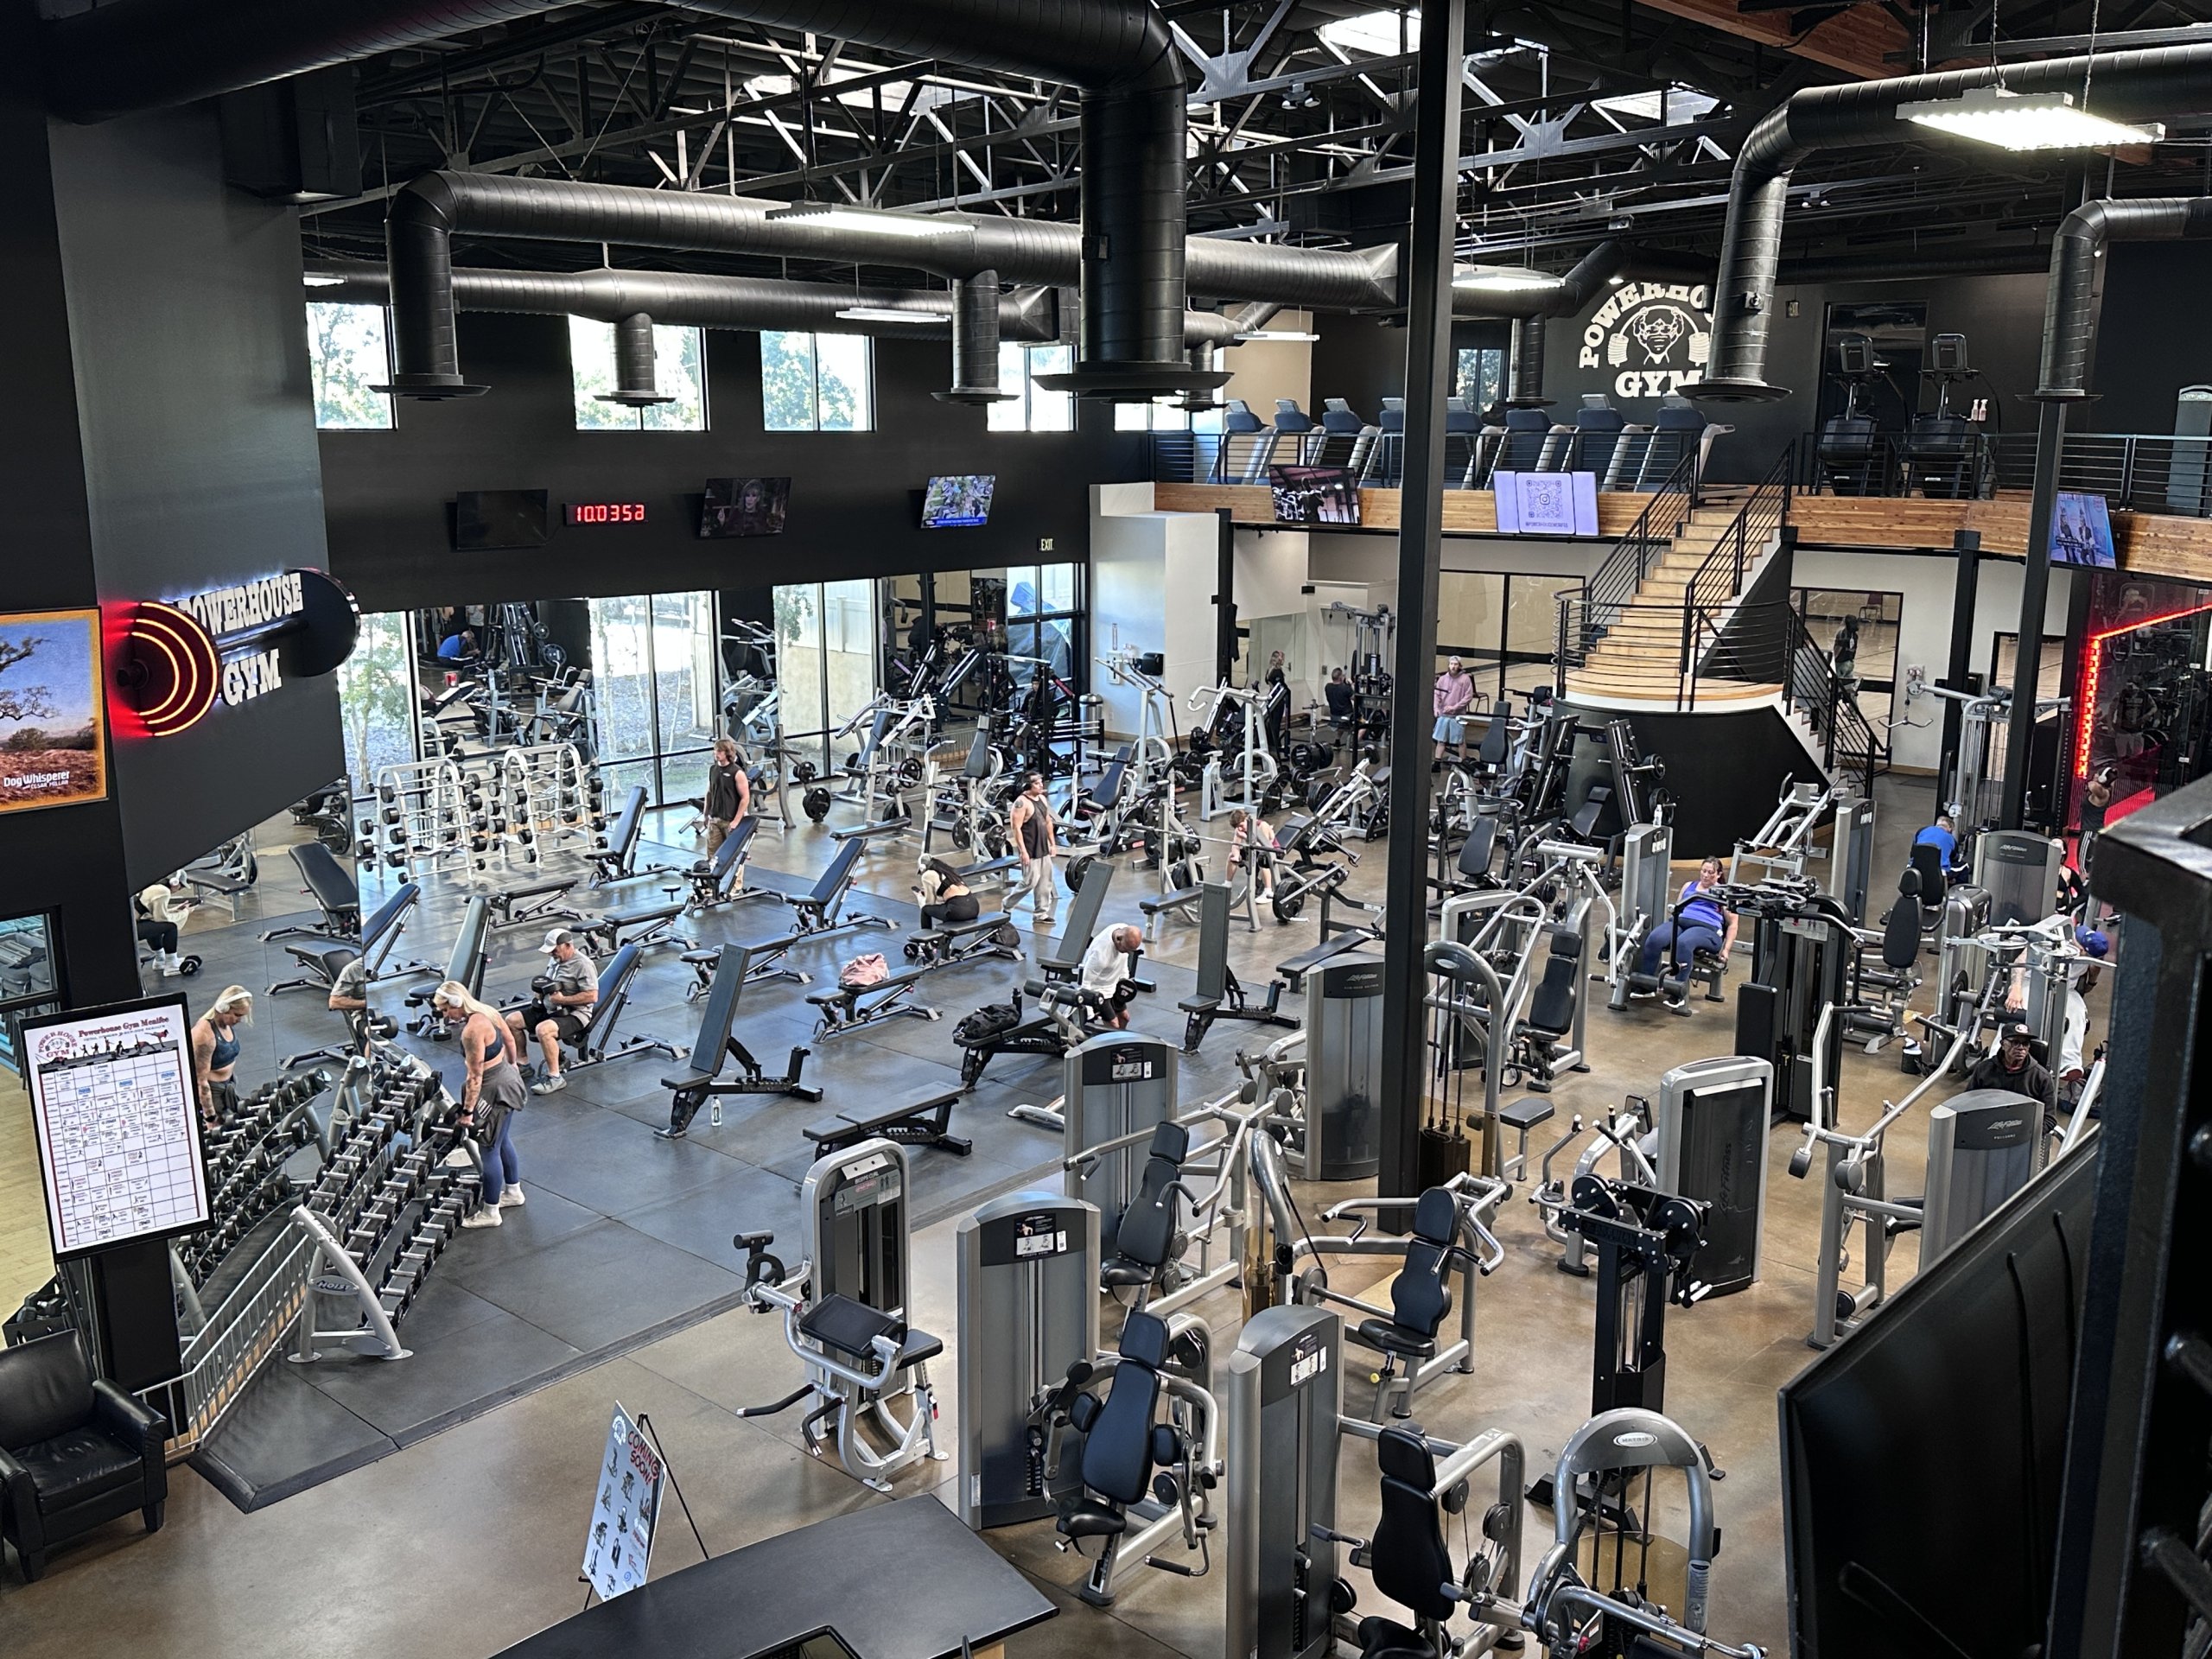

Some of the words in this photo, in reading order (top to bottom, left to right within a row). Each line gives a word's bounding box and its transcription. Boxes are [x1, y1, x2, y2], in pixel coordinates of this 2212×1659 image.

[1615, 370, 1703, 397] GYM
[1040, 538, 1053, 550] EXIT
[222, 648, 283, 706] GYM
[3, 777, 22, 787] Dog
[22, 771, 70, 784] Whisperer
[78, 1026, 122, 1038] Powerhouse
[123, 1021, 140, 1030] Gym
[140, 1016, 169, 1027] Menifee
[47, 1049, 70, 1058] GYM
[317, 1281, 351, 1292] HOIST
[627, 1430, 660, 1480] COMING
[630, 1450, 652, 1485] SOON!
